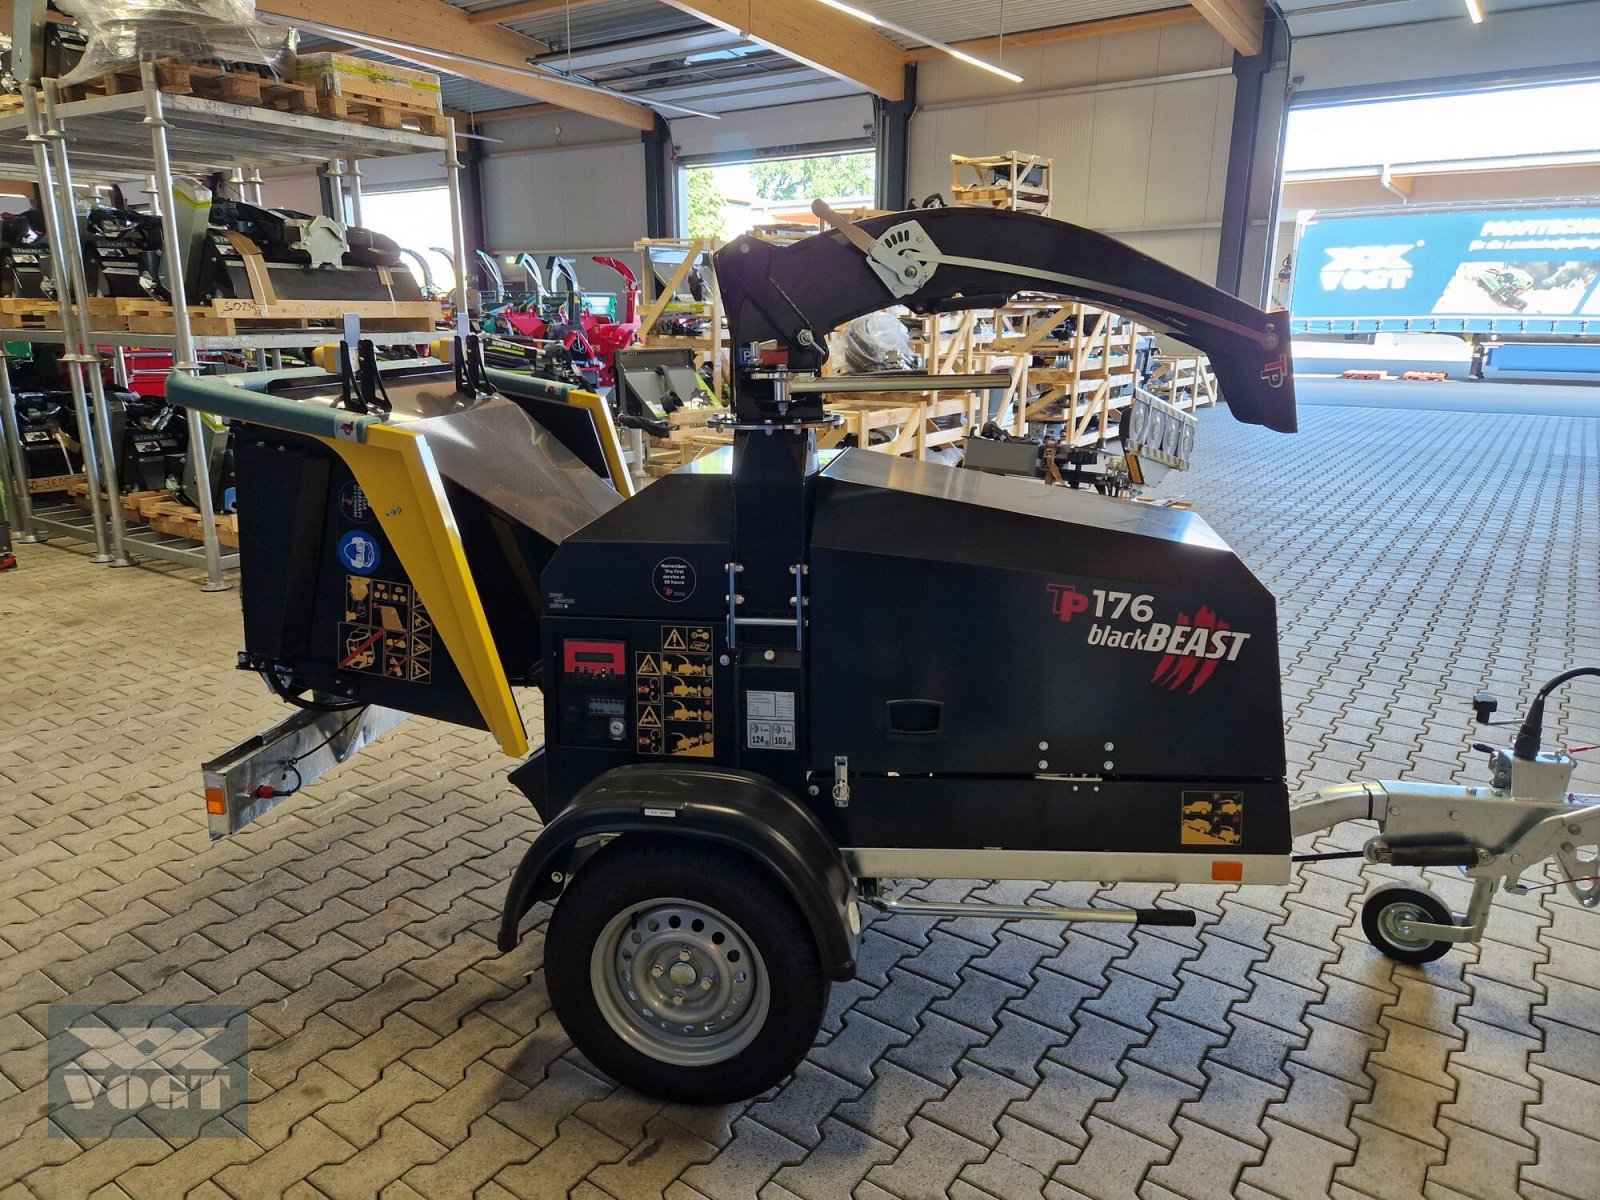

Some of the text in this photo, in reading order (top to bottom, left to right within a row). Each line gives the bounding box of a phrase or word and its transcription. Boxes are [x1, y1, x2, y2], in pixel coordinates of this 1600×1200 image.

[1320, 270, 1413, 291] VOGT
[1260, 353, 1288, 389] TP
[1046, 583, 1155, 623] TP 176
[1087, 622, 1251, 661] blackBEAST
[752, 735, 764, 744] 124
[774, 736, 787, 745] 103
